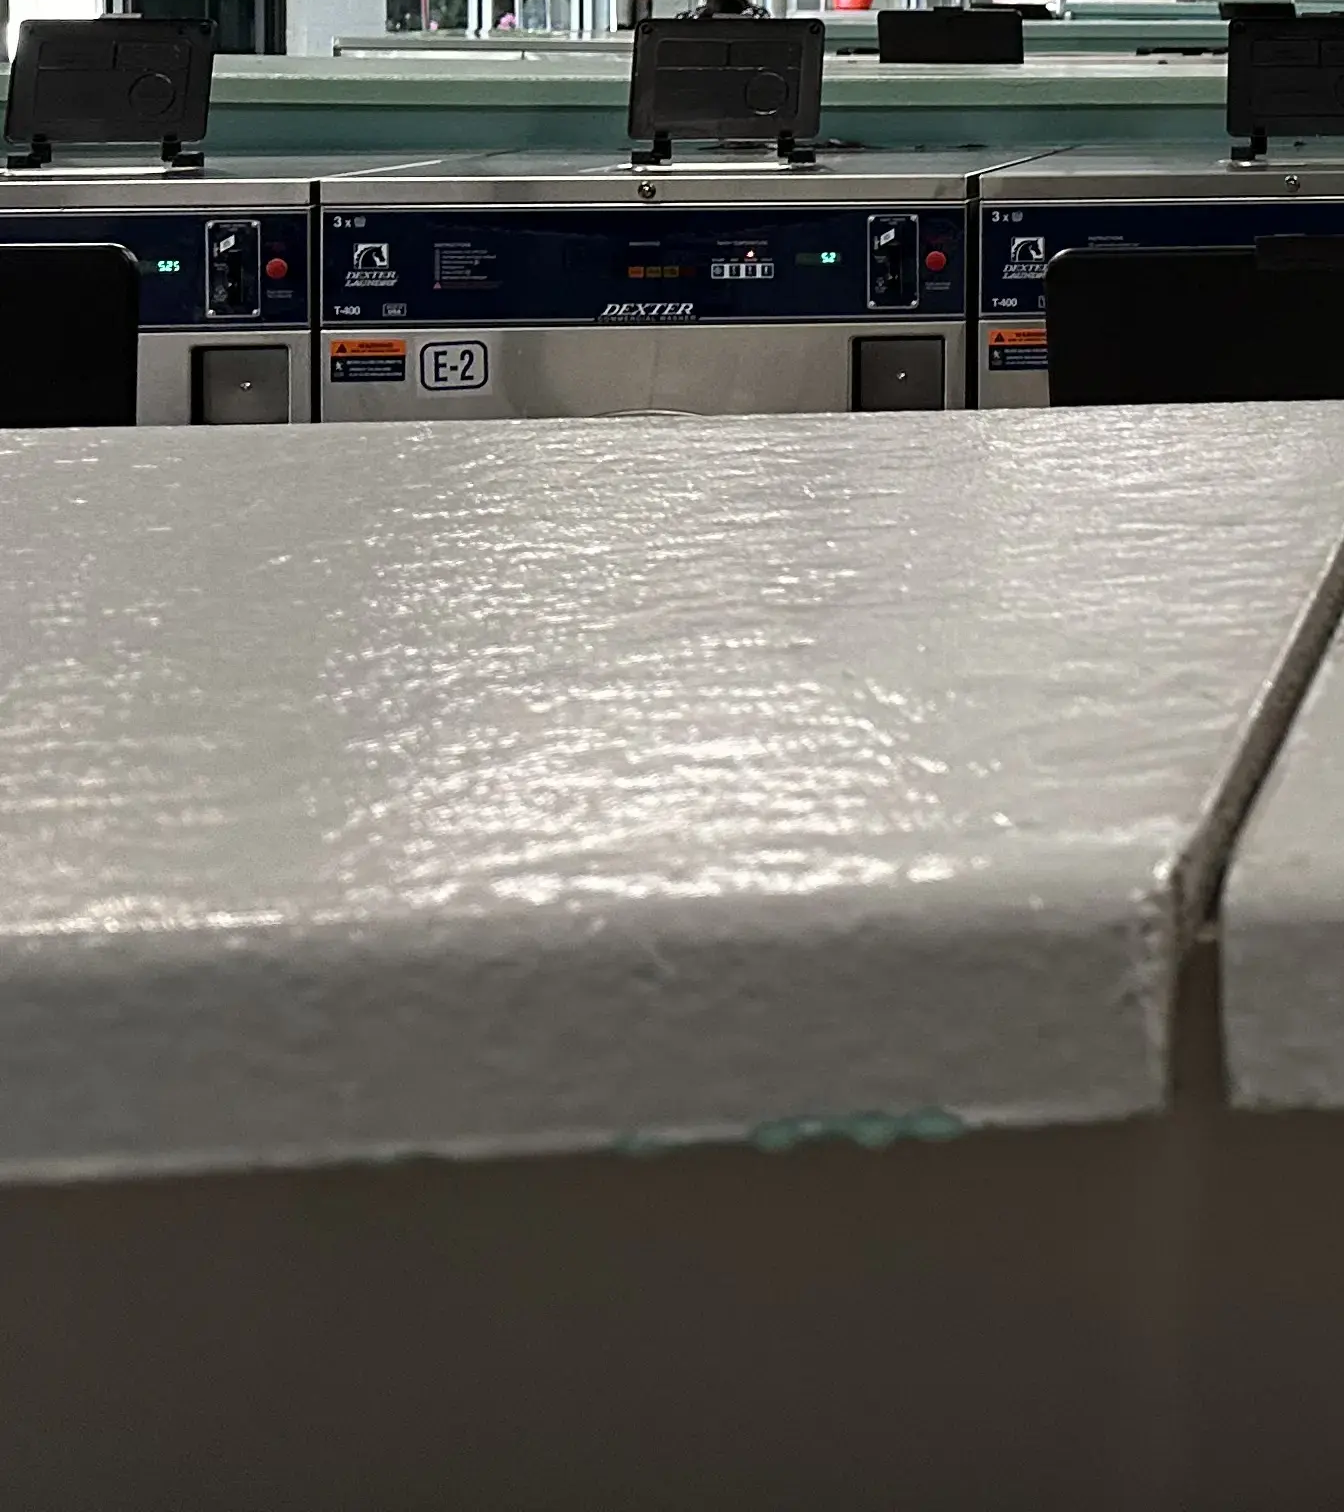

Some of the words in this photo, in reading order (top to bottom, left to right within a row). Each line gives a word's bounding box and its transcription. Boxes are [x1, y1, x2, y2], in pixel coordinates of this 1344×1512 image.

[331, 215, 343, 228] 3
[991, 210, 1000, 222] 3
[345, 270, 397, 280] DEXTER
[991, 297, 1018, 308] T-400
[600, 302, 695, 316] DEXTER
[433, 349, 474, 383] E-2
